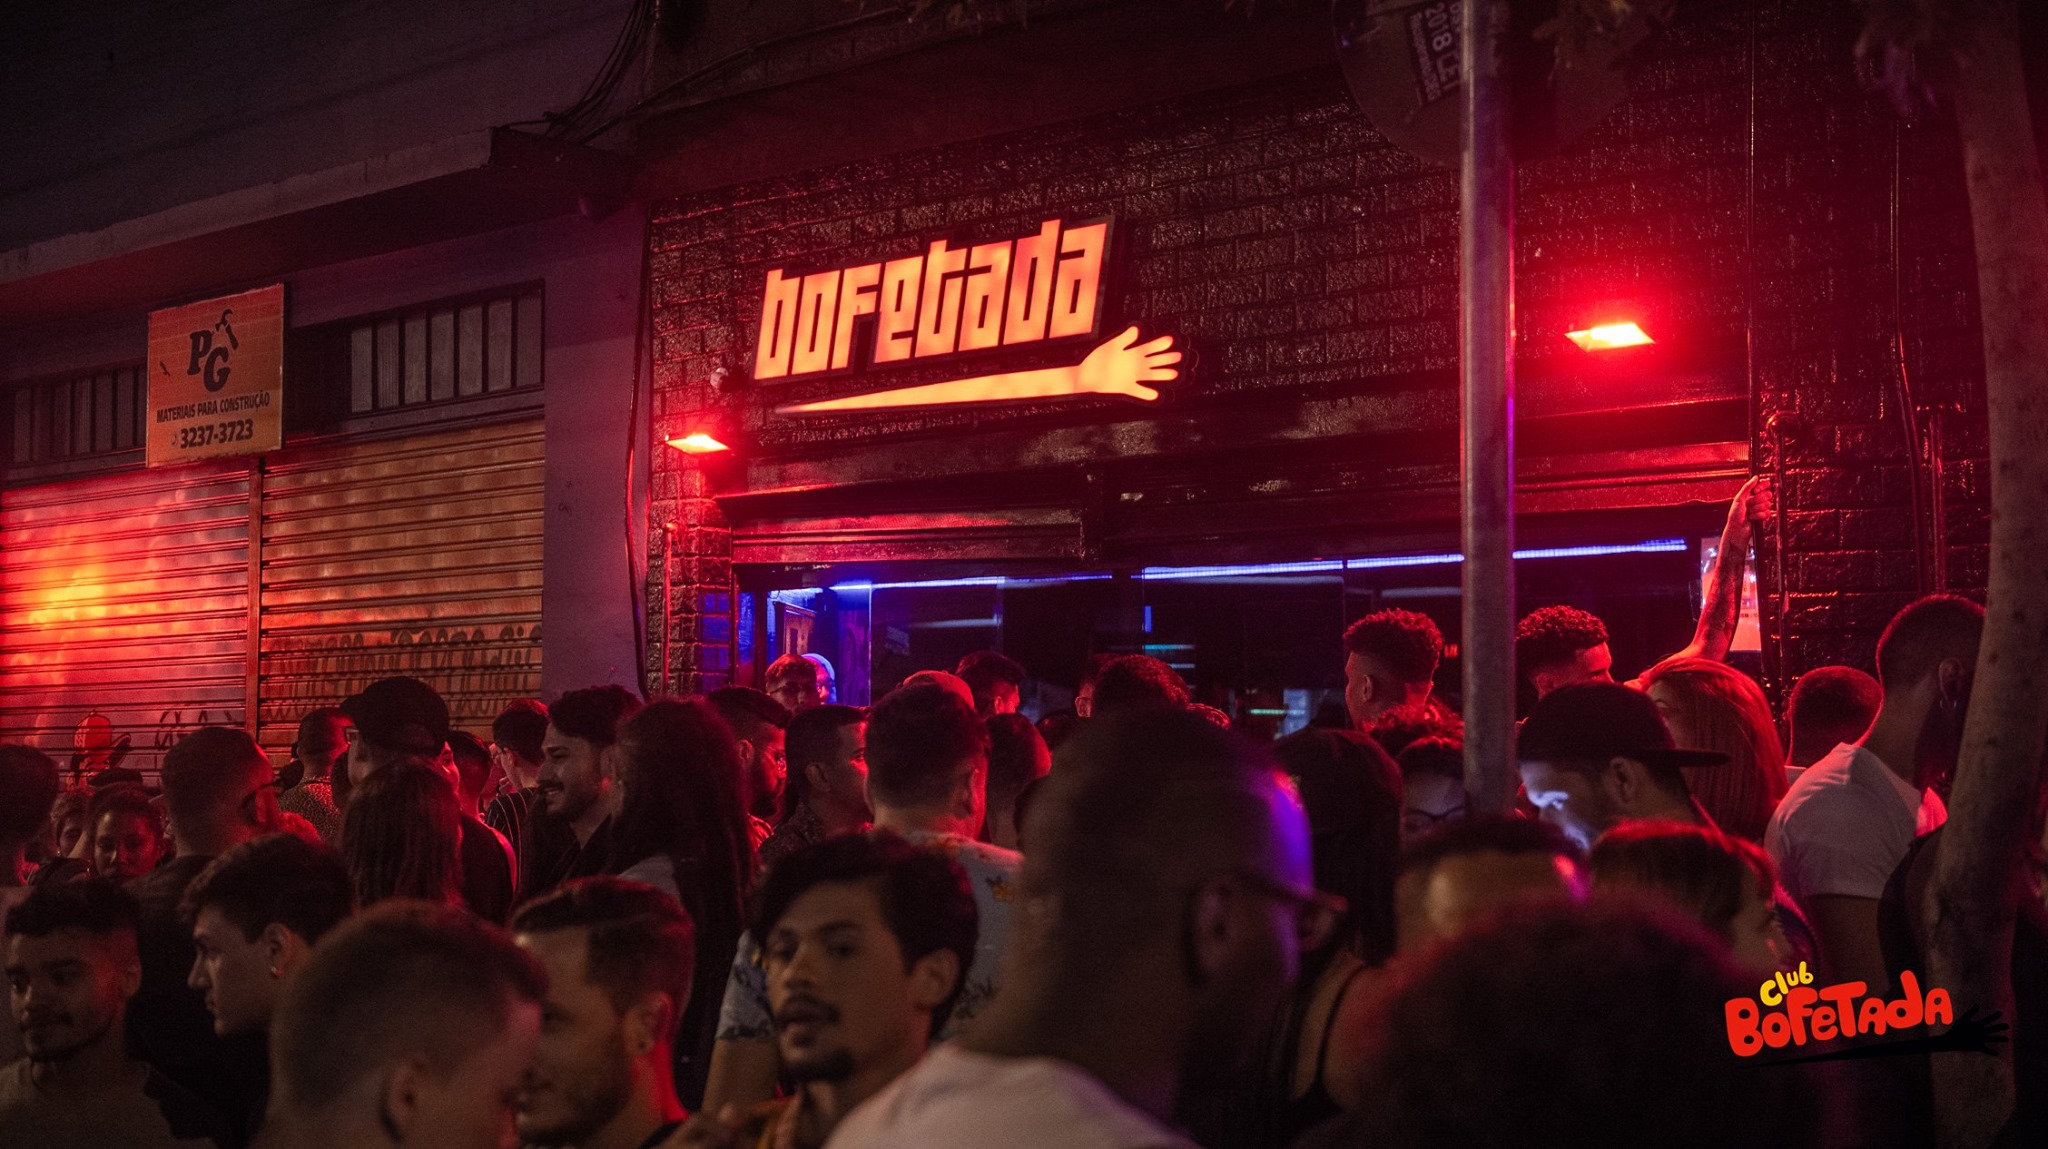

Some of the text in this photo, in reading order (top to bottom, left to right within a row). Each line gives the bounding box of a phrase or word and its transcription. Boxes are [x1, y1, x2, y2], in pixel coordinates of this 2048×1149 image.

[156, 389, 270, 424] MATERIAIS PARA CONSTRUÇÃO
[180, 418, 254, 449] 3237-3723
